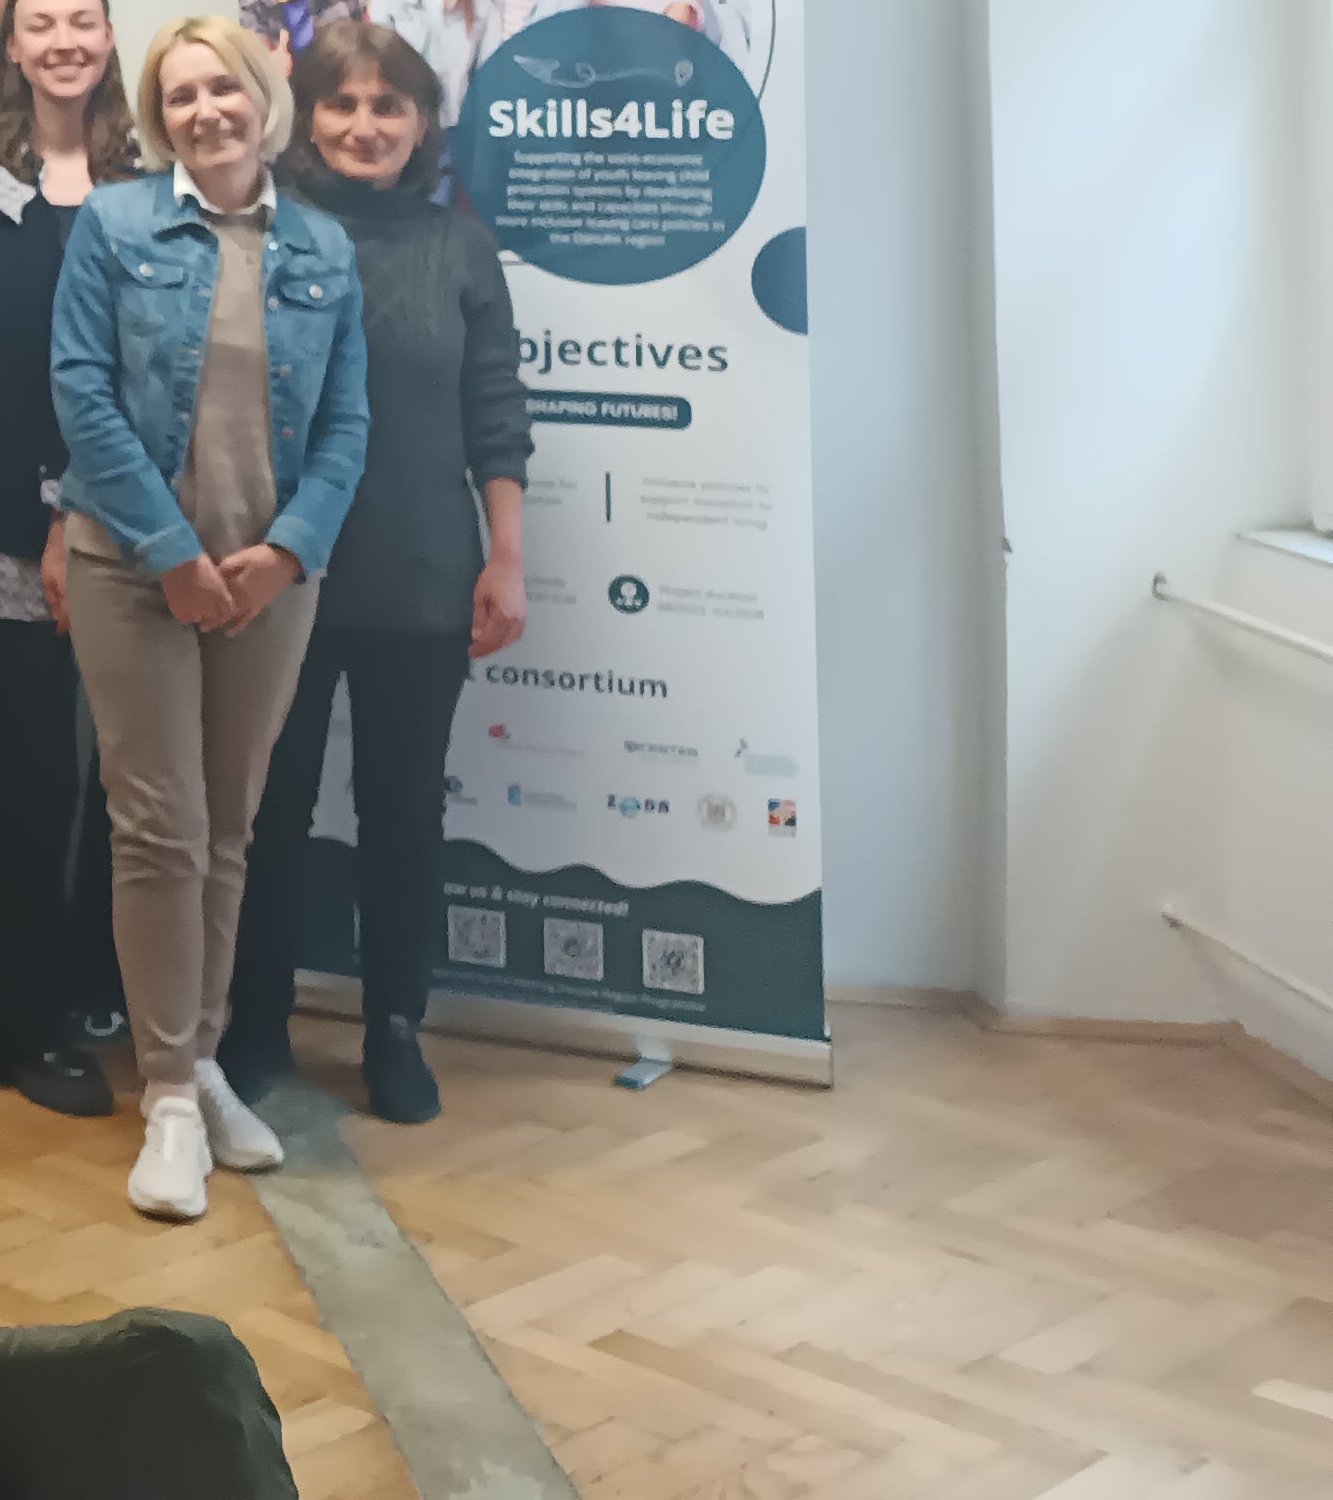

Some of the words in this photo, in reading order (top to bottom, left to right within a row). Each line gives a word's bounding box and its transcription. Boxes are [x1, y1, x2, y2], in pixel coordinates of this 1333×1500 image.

[489, 97, 735, 139] Skills4Life
[519, 329, 729, 376] bjectives
[485, 664, 669, 699] consortium
